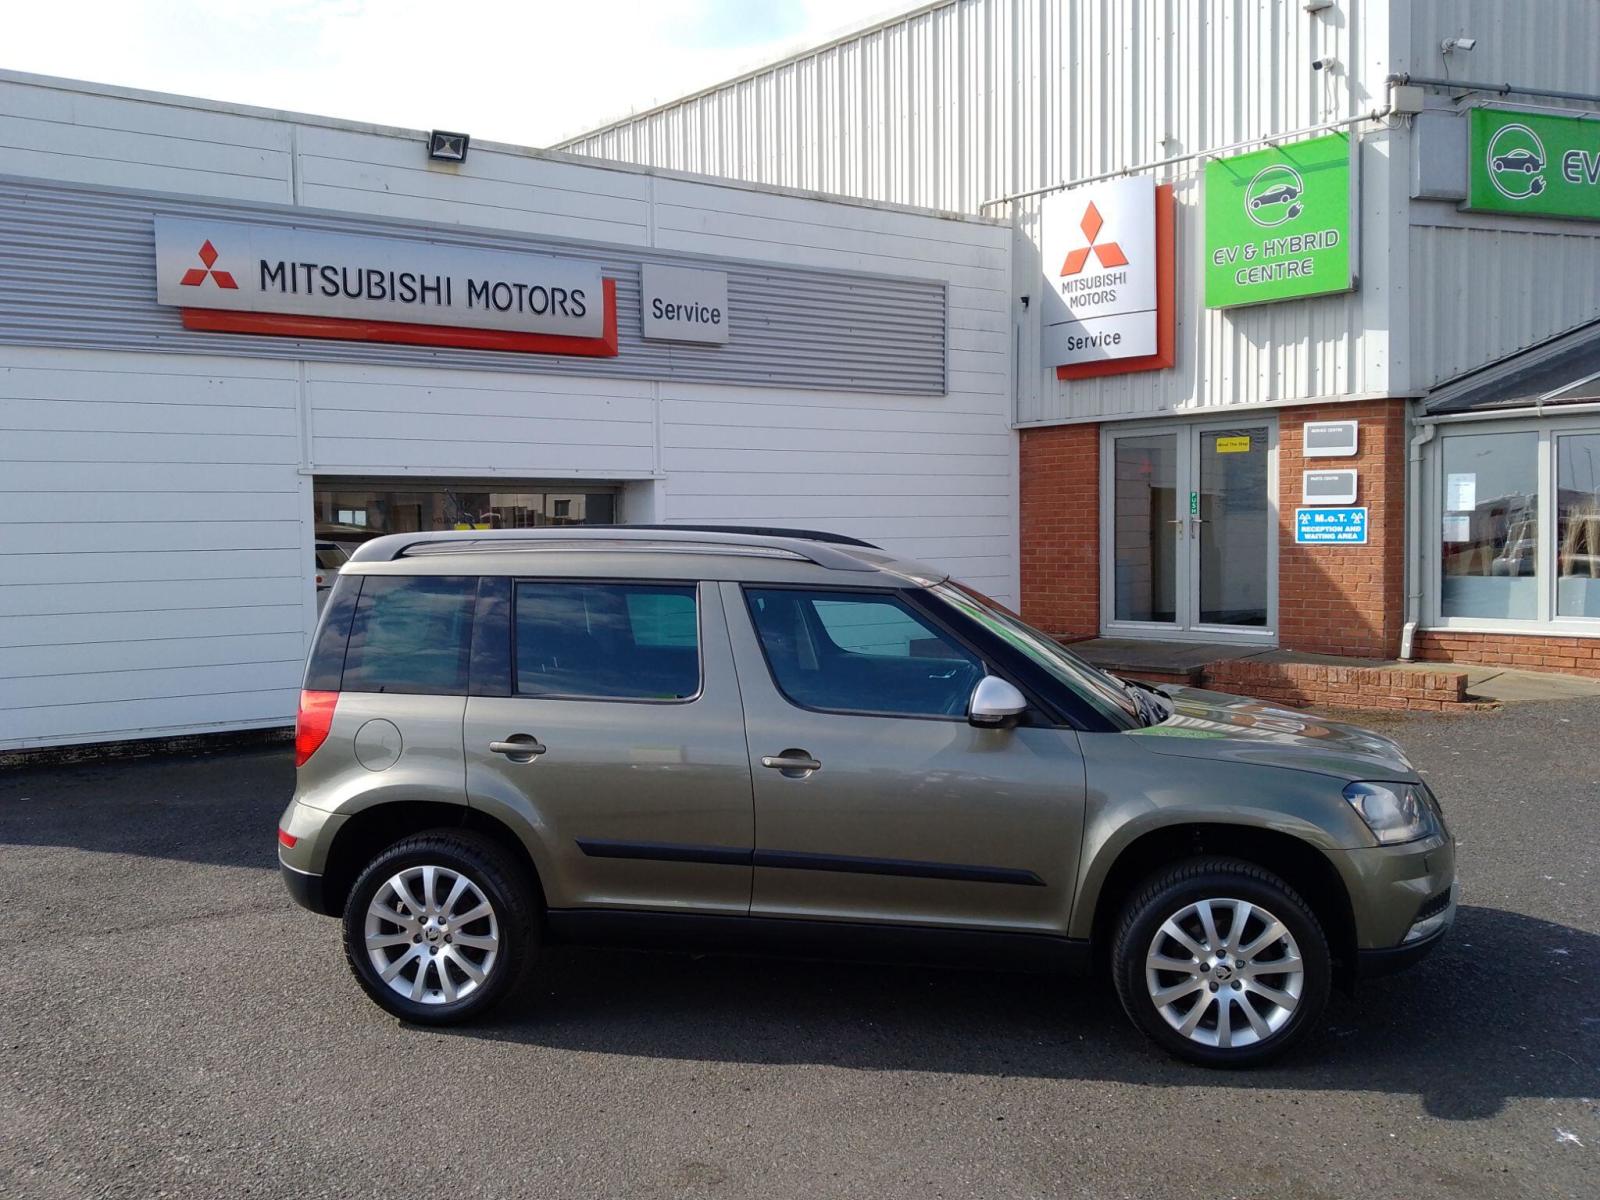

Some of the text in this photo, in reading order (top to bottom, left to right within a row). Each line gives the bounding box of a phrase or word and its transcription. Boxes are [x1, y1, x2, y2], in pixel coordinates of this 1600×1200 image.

[1562, 149, 1600, 184] EV
[1213, 229, 1339, 266] EV & HYBRID
[1062, 271, 1127, 294] MITSUBISHI
[1235, 258, 1313, 285] CENTRE
[258, 259, 586, 317] MITSUBISHI MOTORS
[1070, 289, 1116, 308] MOTORS
[652, 297, 721, 325] Service
[1067, 331, 1121, 351] Service
[1314, 513, 1347, 523] M.o.T.
